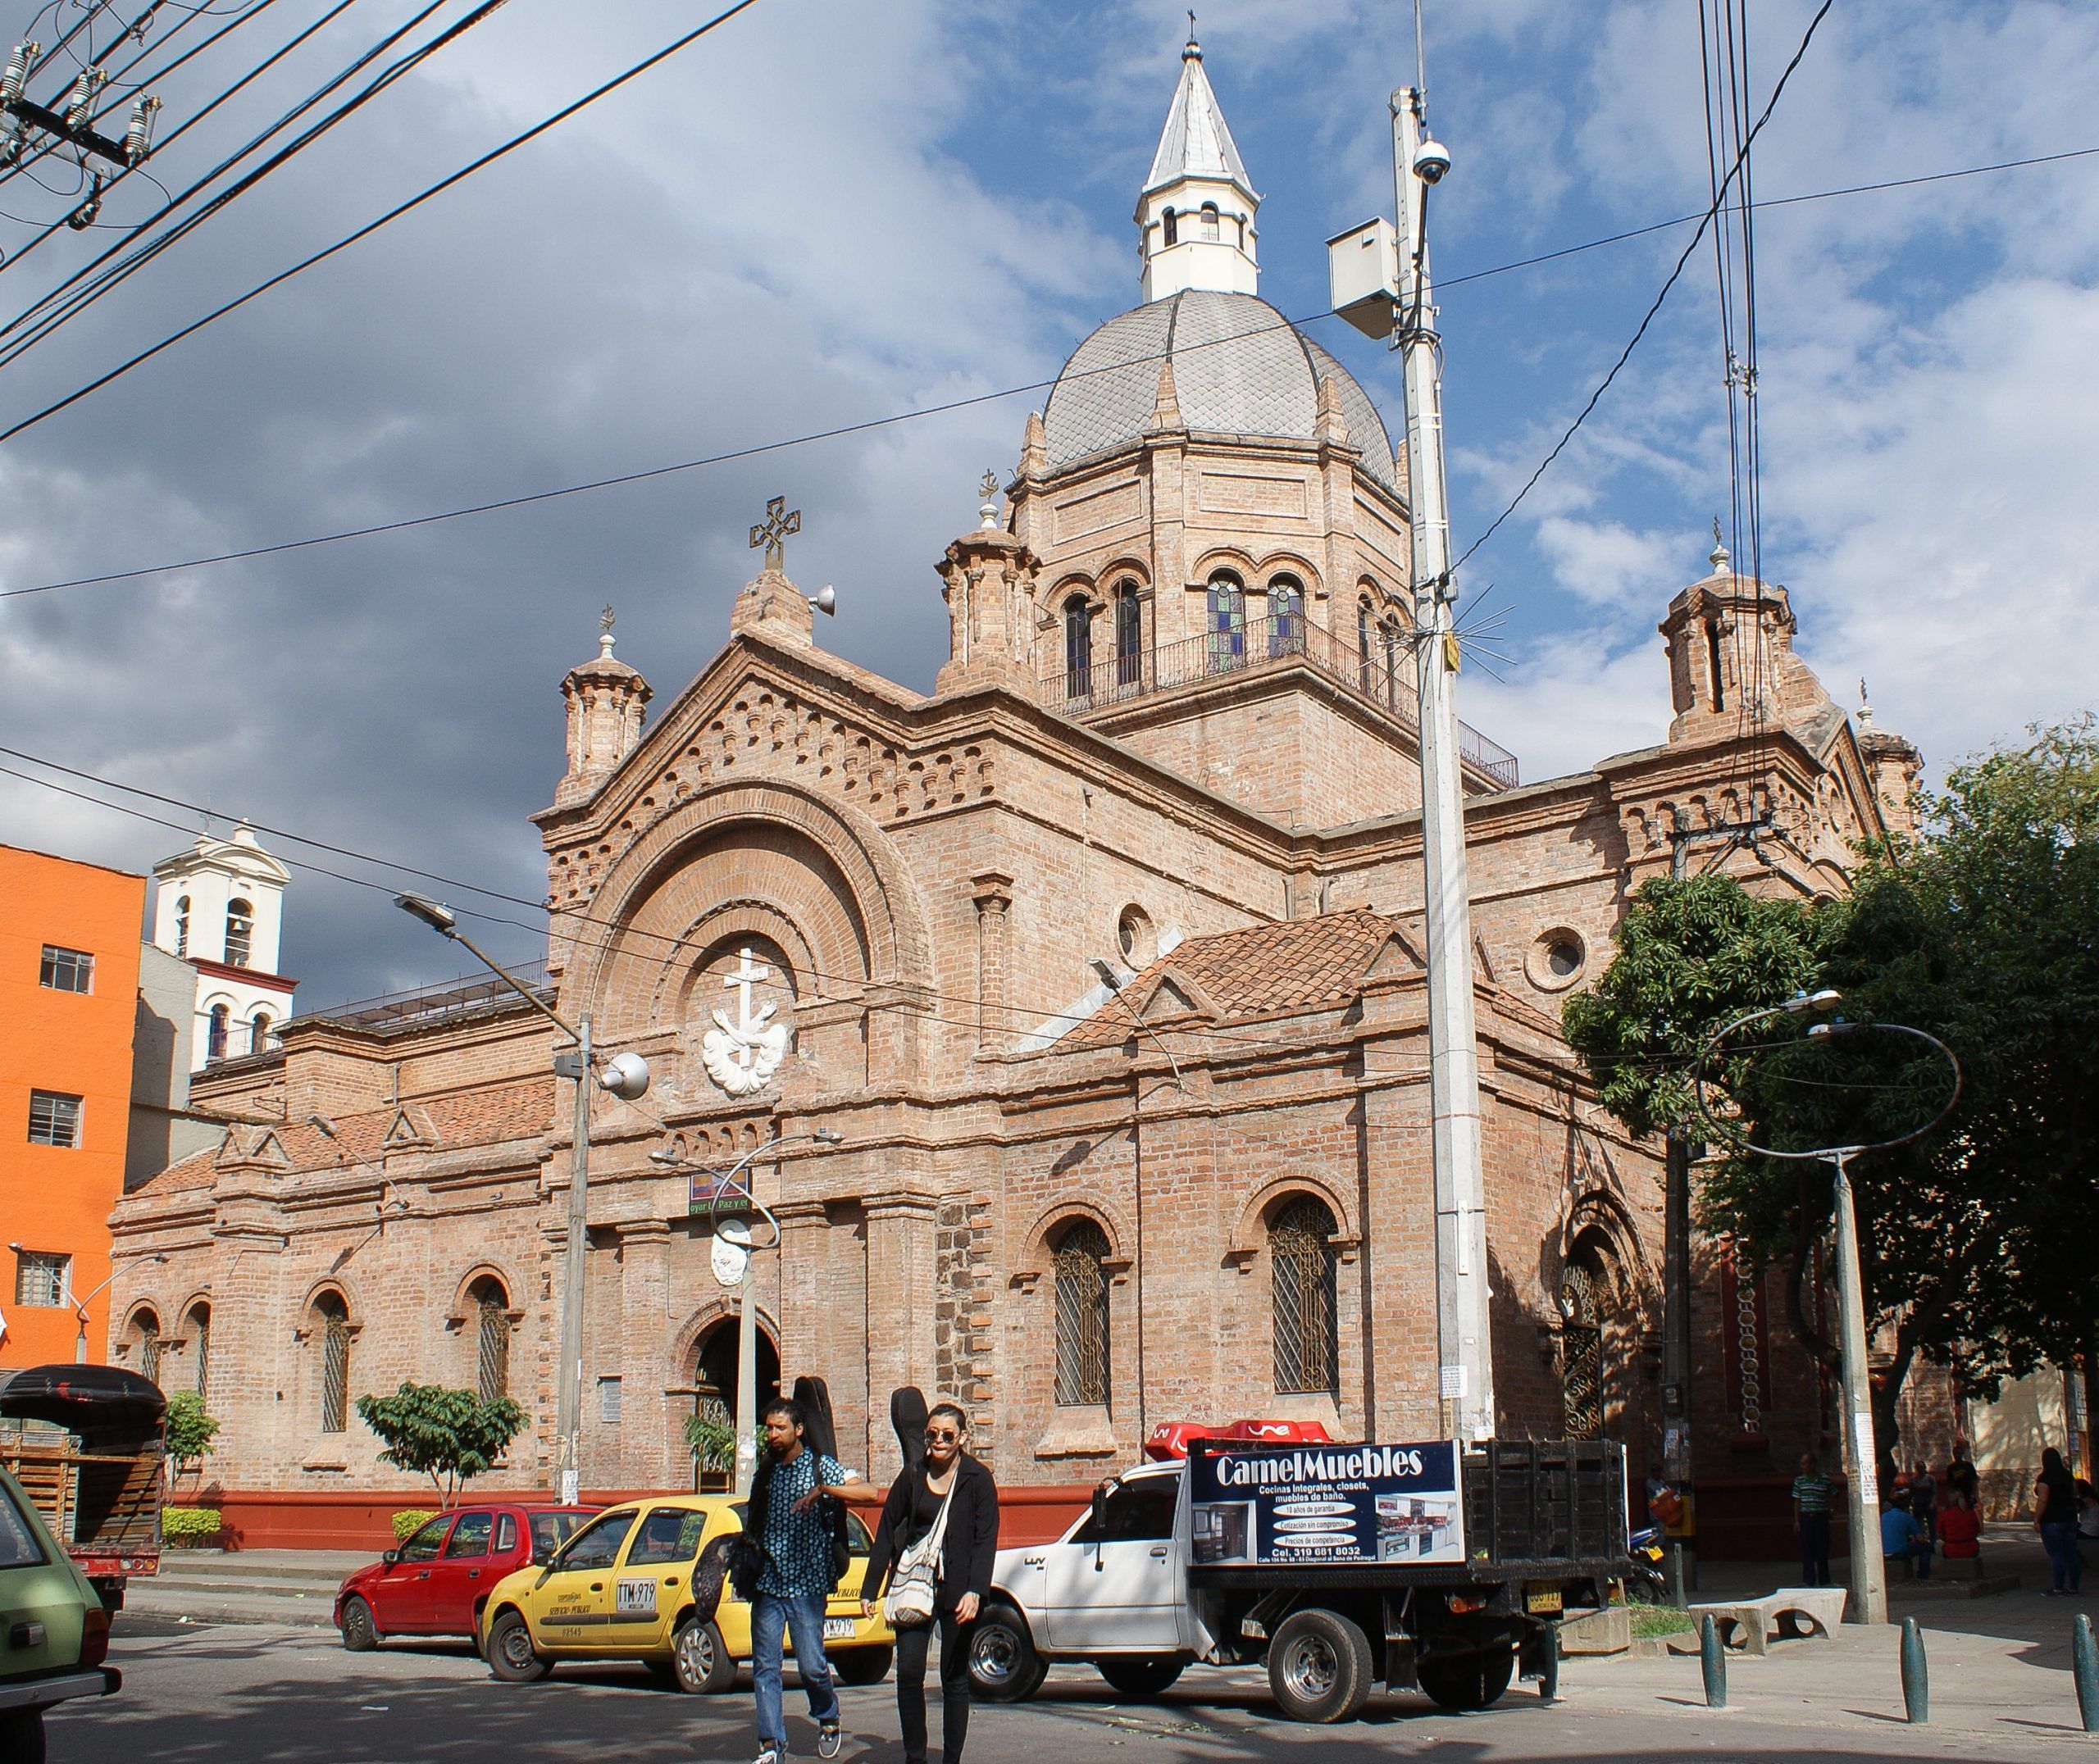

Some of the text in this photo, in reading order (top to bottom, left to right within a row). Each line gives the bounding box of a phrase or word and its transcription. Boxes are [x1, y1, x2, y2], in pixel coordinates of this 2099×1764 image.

[690, 1203, 707, 1213] oyar
[718, 1200, 732, 1208] Paz
[734, 1200, 739, 1209] y
[1248, 1425, 1291, 1436] une
[1217, 1447, 1423, 1486] CamelMuebles
[1259, 1482, 1369, 1494] Cocinas Integrales, closets,
[1275, 1493, 1309, 1503] muebles
[1311, 1493, 1322, 1501] de
[1294, 1505, 1305, 1513] años
[1313, 1536, 1345, 1545] competencia
[1335, 1547, 1360, 1555] 8032
